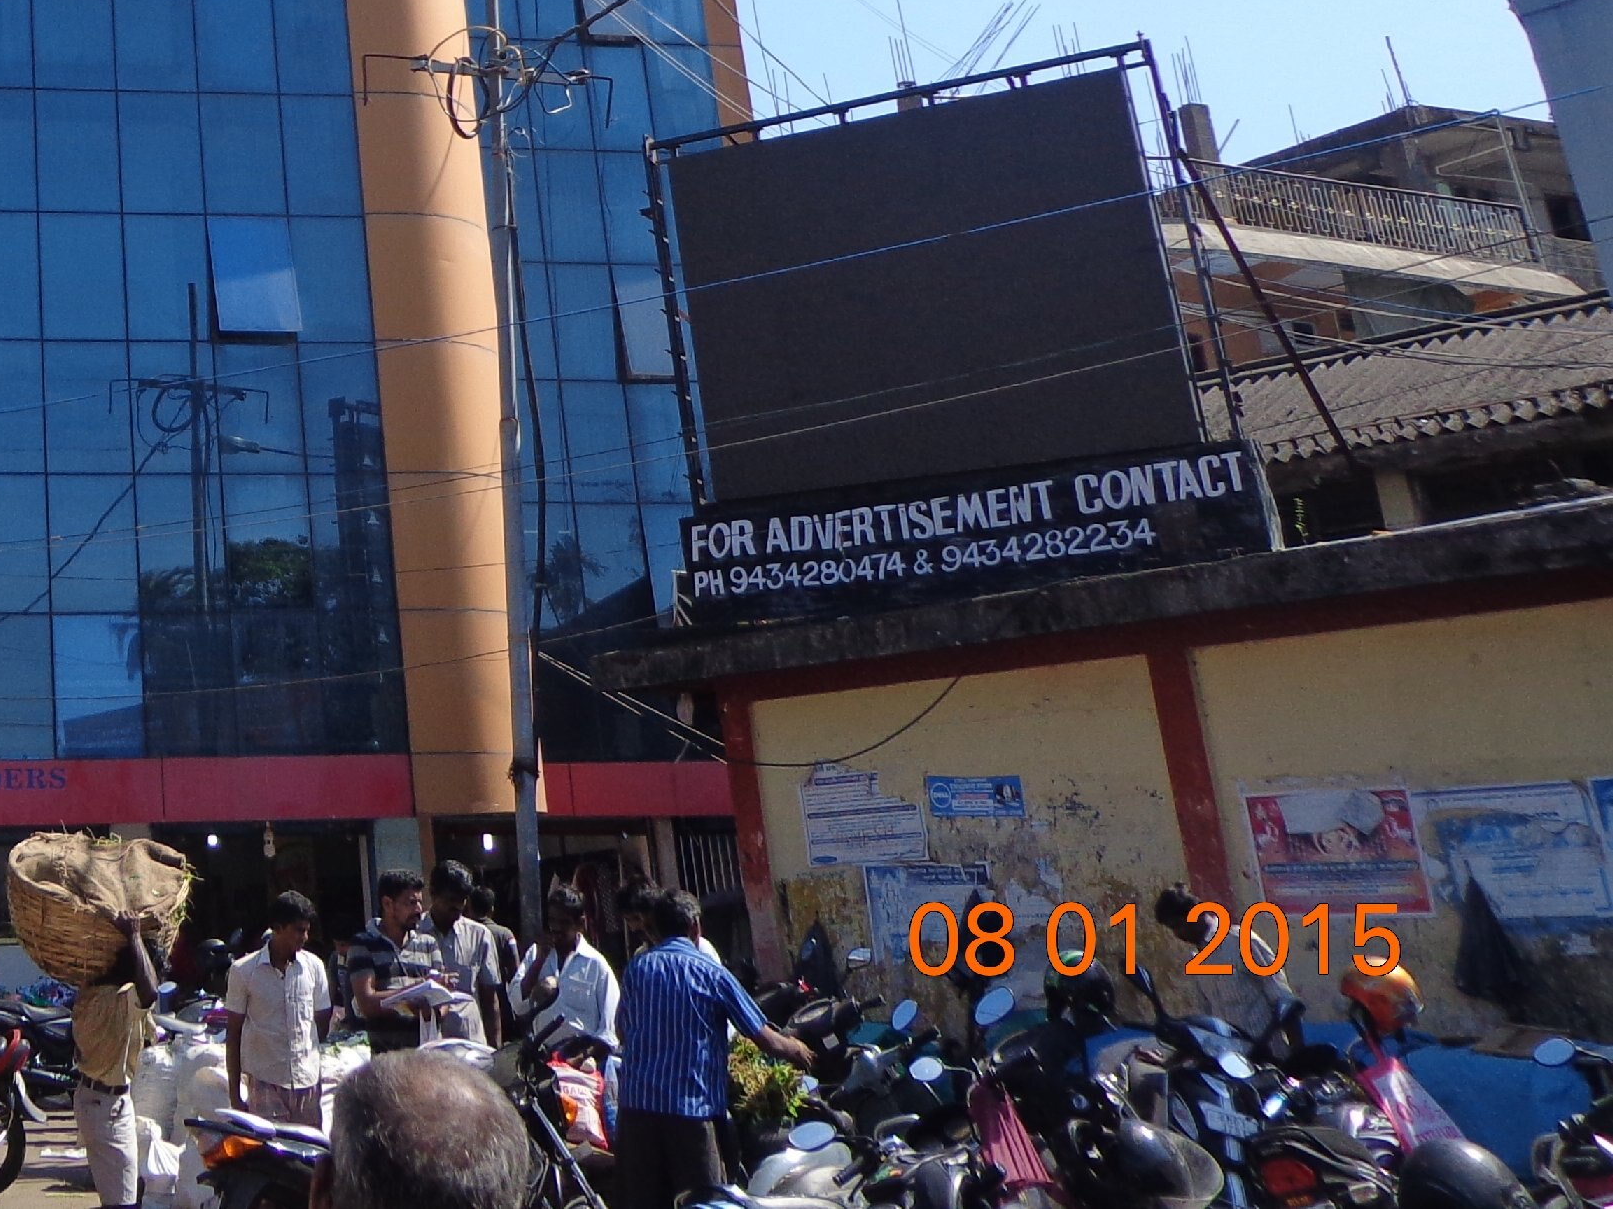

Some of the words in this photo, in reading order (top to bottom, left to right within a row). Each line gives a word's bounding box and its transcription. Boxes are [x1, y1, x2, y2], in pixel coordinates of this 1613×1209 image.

[691, 518, 755, 562] FOR
[766, 480, 1053, 554] ADVERTISEMENT
[1076, 451, 1244, 515] CONTACT
[694, 570, 725, 598] PH
[729, 553, 904, 593] 9434280474
[914, 549, 933, 575] &
[942, 519, 1157, 567] 9434282234
